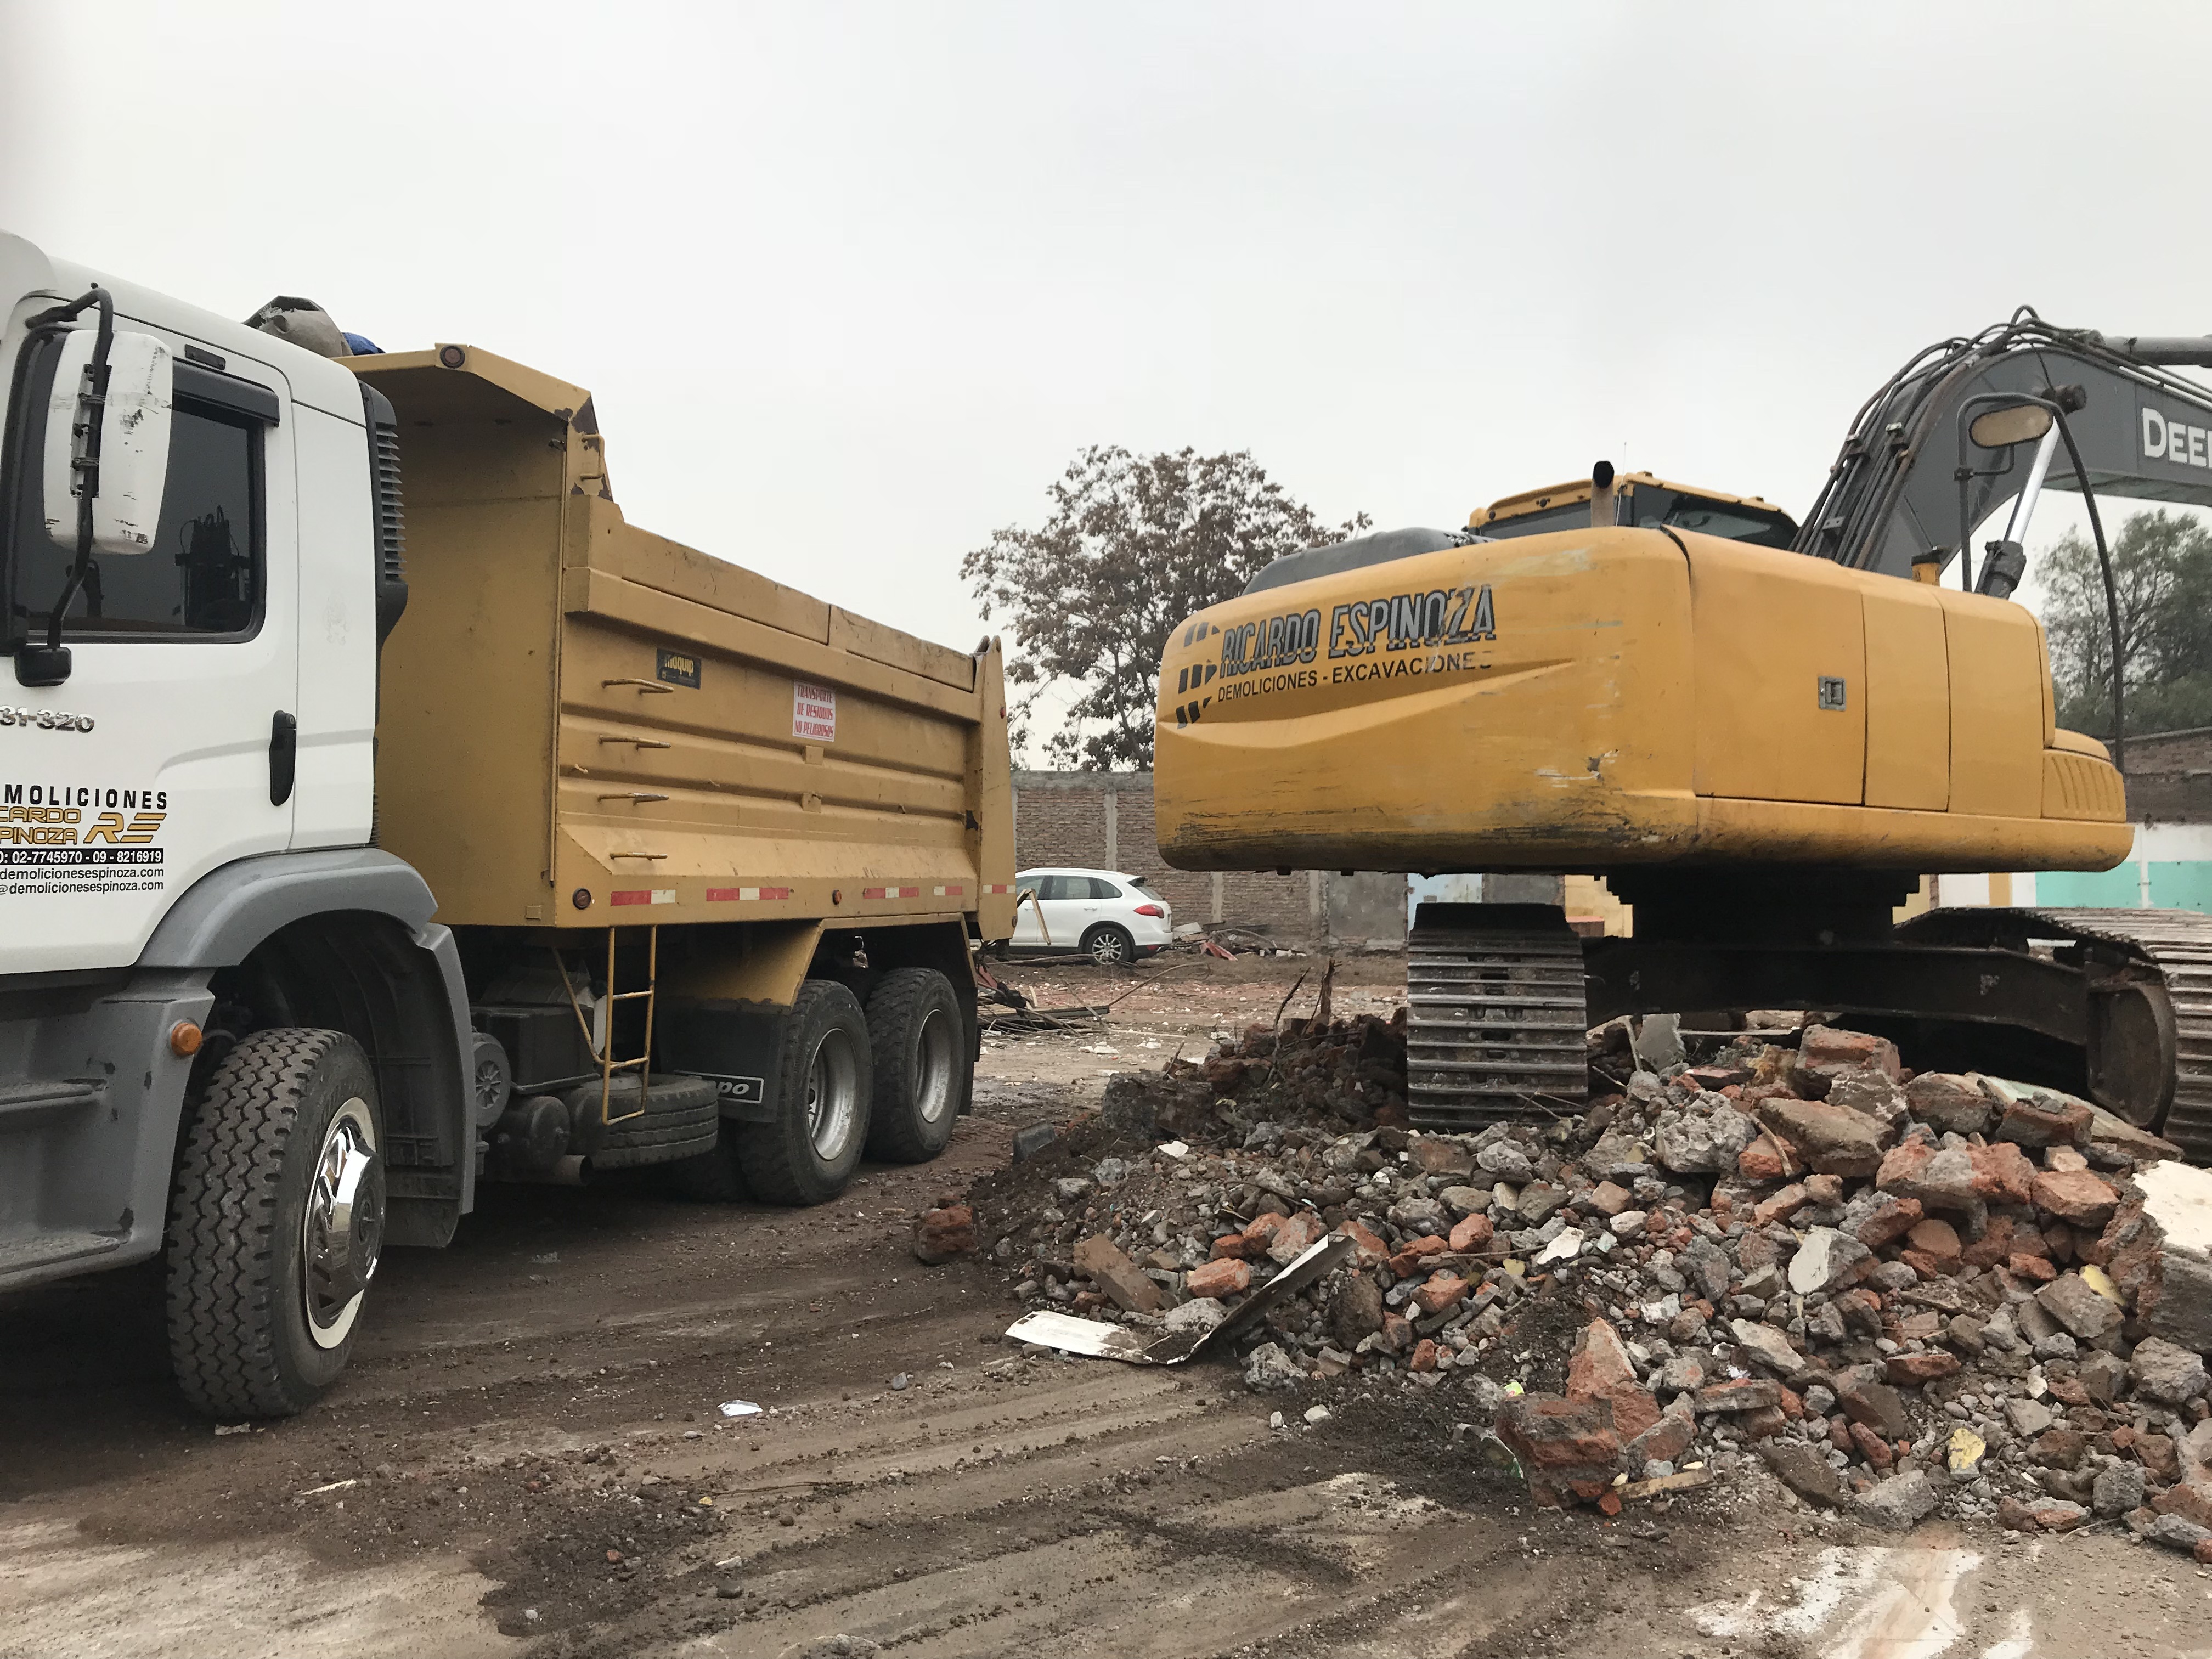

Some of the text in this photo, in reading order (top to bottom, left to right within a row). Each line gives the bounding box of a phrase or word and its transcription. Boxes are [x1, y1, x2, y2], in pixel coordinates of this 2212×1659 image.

[2143, 407, 2212, 469] DEE
[1220, 584, 1497, 679] RICARDO ESPINOZA
[797, 684, 833, 703] TRANSPORTE
[1218, 670, 1317, 702] DEMOLICIONES
[0, 705, 95, 733] 31-320
[797, 702, 833, 720] DE RESIDUOS
[795, 720, 834, 738] NO PELIGROSOS
[4, 784, 167, 809] MOLICIONES
[0, 826, 77, 845] PINOZA
[12, 851, 82, 864] 02-7745970
[93, 851, 107, 863] 09
[117, 851, 161, 862] 8216919
[0, 867, 164, 881] demolicionesespinoza.com
[0, 880, 163, 895] @demolicionesespinoza.com
